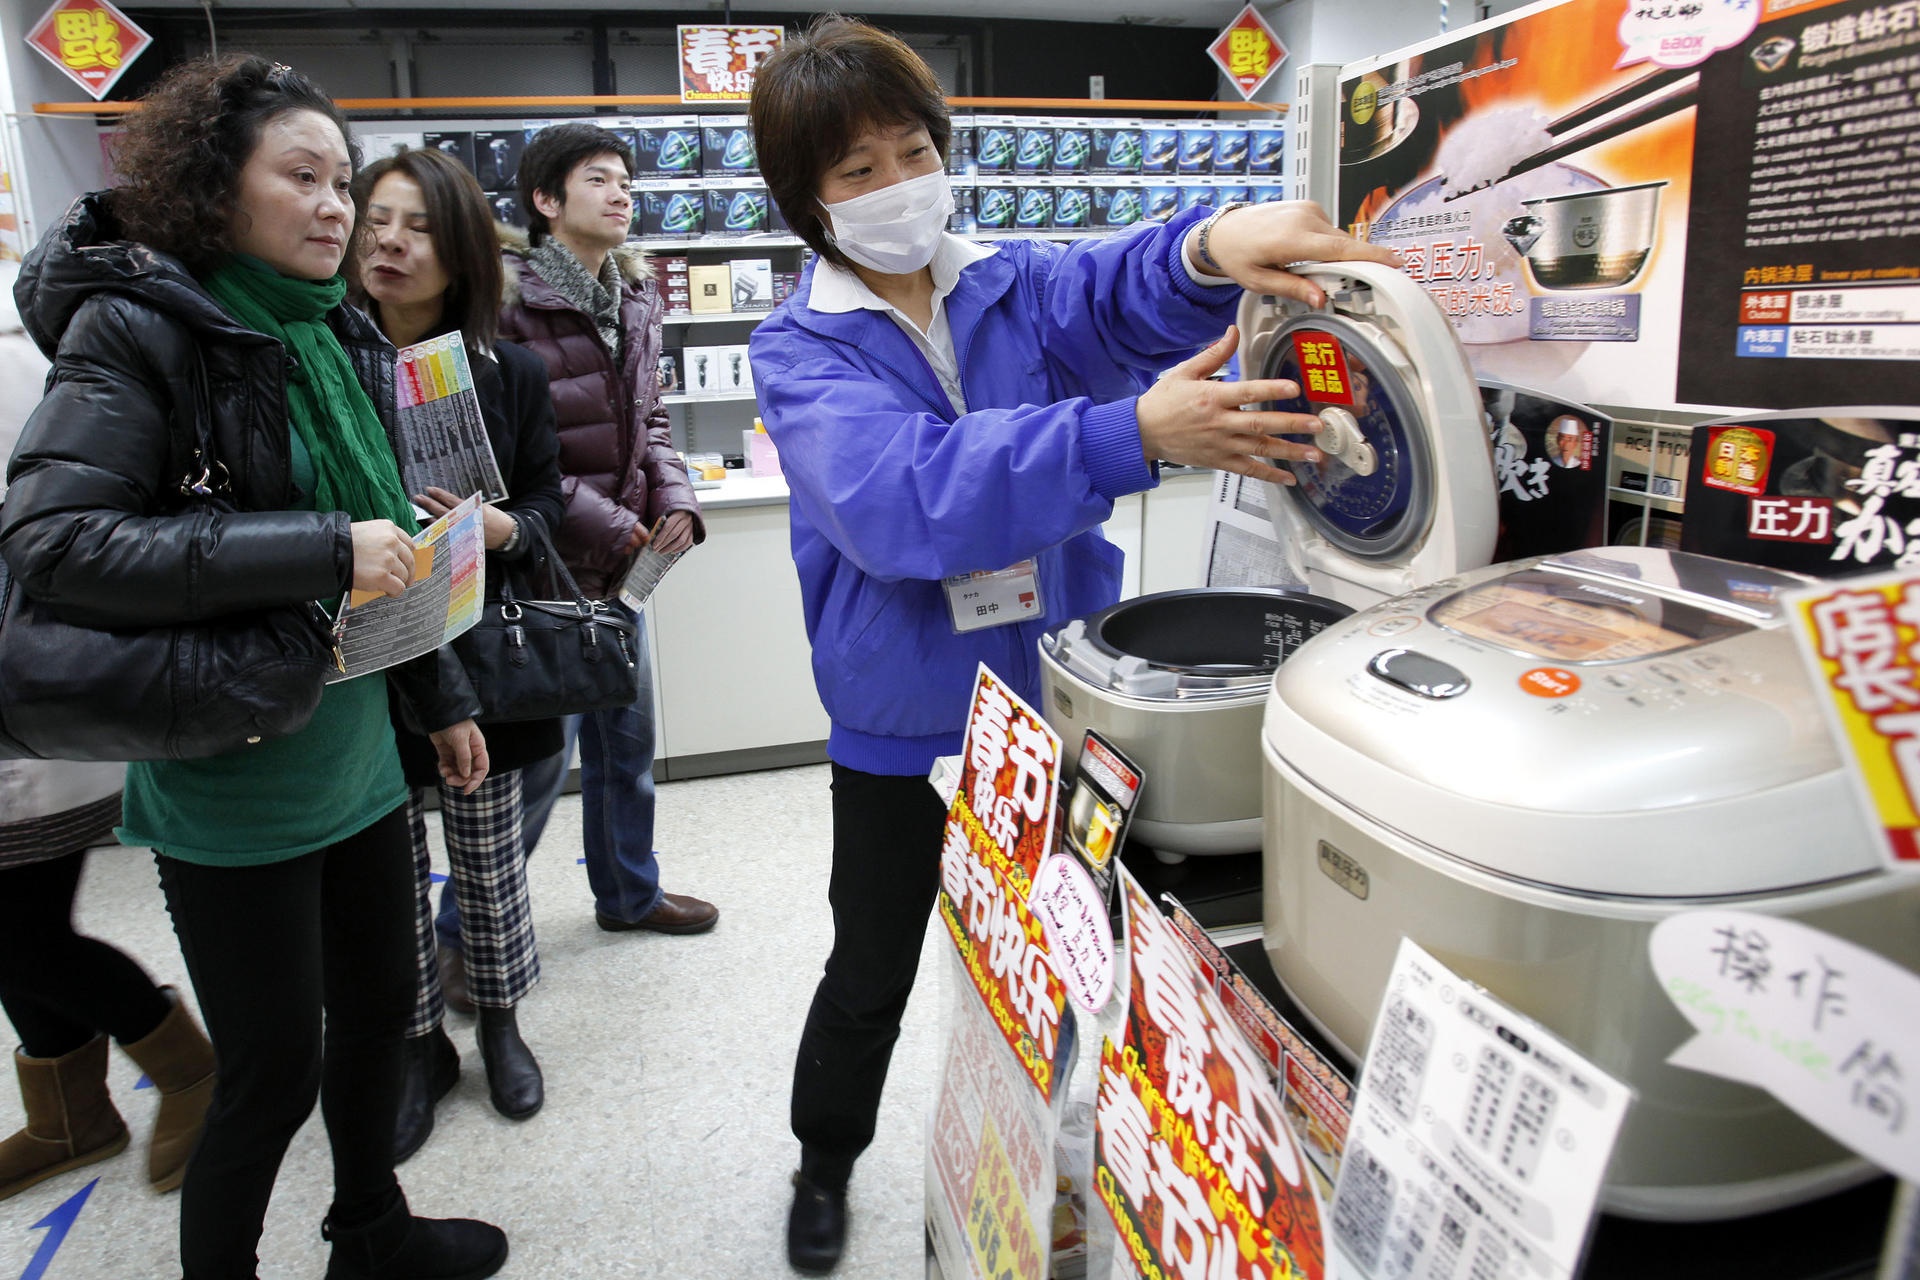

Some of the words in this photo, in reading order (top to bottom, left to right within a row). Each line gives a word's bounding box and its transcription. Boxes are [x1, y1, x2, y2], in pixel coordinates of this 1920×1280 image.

[1801, 2, 1920, 53] 锻造钻石
[684, 29, 778, 73] 春节
[685, 91, 718, 100] Chinese
[740, 91, 752, 99] Ye
[707, 68, 755, 92] 快乐
[1387, 237, 1495, 282] 空压力，
[1745, 295, 1788, 308] 外表面
[1747, 311, 1783, 319] Outside
[1743, 329, 1785, 343] 内表面
[1307, 369, 1344, 393] 商品
[1750, 498, 1830, 540] 圧力
[976, 602, 999, 617] 田中
[1526, 671, 1570, 695] Start
[971, 683, 1056, 823] 春节
[973, 765, 1021, 859] 快乐
[939, 820, 1063, 1061] 春节快乐
[940, 891, 970, 957] Chinese
[967, 953, 990, 996] New
[988, 987, 1014, 1036] Year
[1130, 897, 1301, 1188] 春节
[1122, 1045, 1176, 1133] Chinese
[1173, 1116, 1216, 1184] New
[1215, 1162, 1260, 1243] Year
[1164, 1031, 1267, 1219] 快乐
